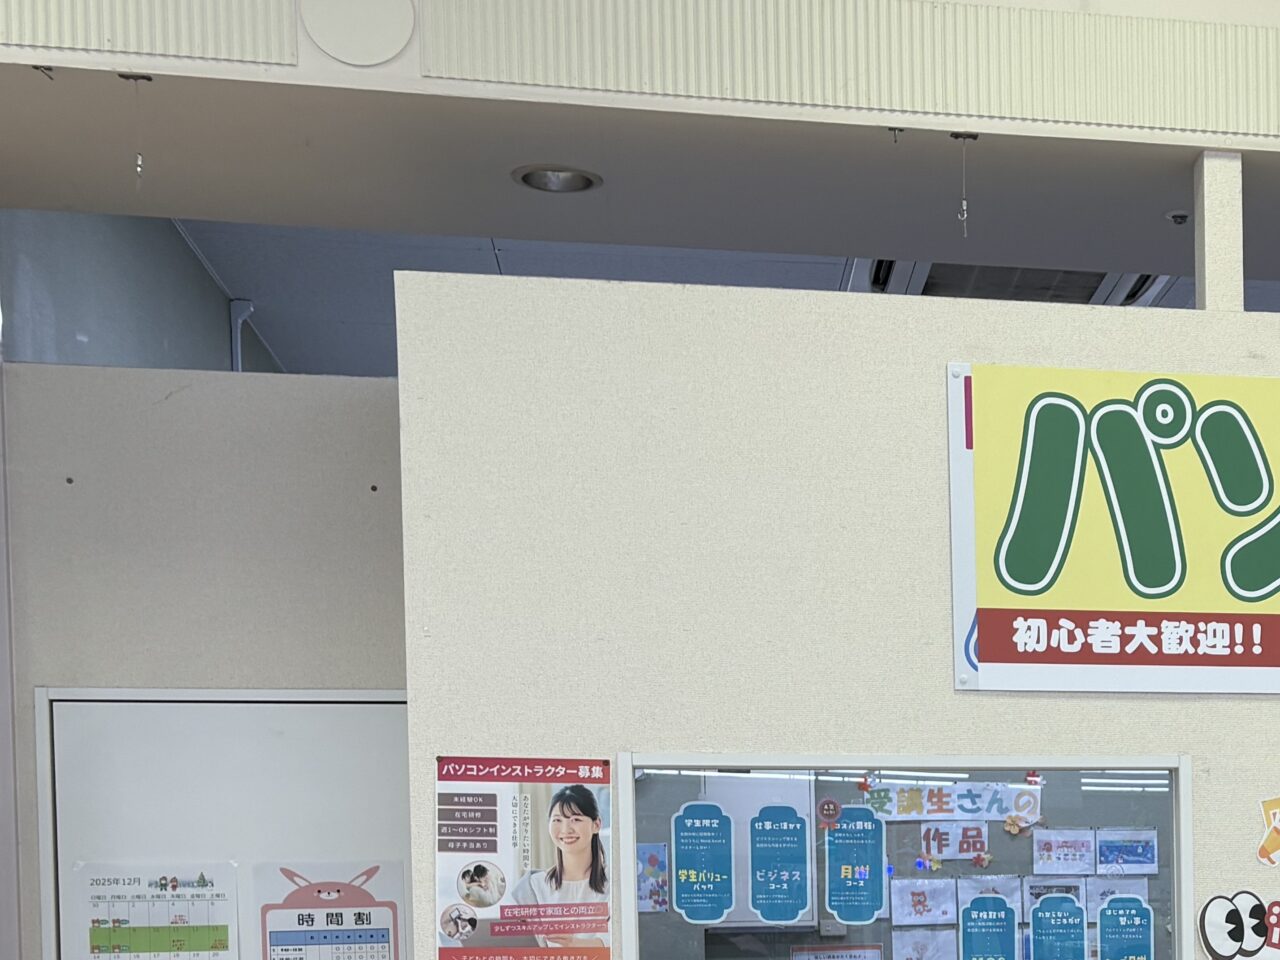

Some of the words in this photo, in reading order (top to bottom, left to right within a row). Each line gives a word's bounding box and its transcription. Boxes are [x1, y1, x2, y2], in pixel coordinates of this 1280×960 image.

[1012, 616, 1263, 656] 初心者大歓迎!!
[442, 764, 604, 779] パソコンインストラクター募集
[866, 787, 1039, 817] 受講生さんの
[685, 819, 720, 828] 学生限定
[922, 826, 987, 854] 作品
[90, 877, 141, 887] 2025年12月
[678, 869, 729, 883] 学生バリュー
[756, 870, 801, 881] ビジネス
[297, 911, 372, 927] 時間割
